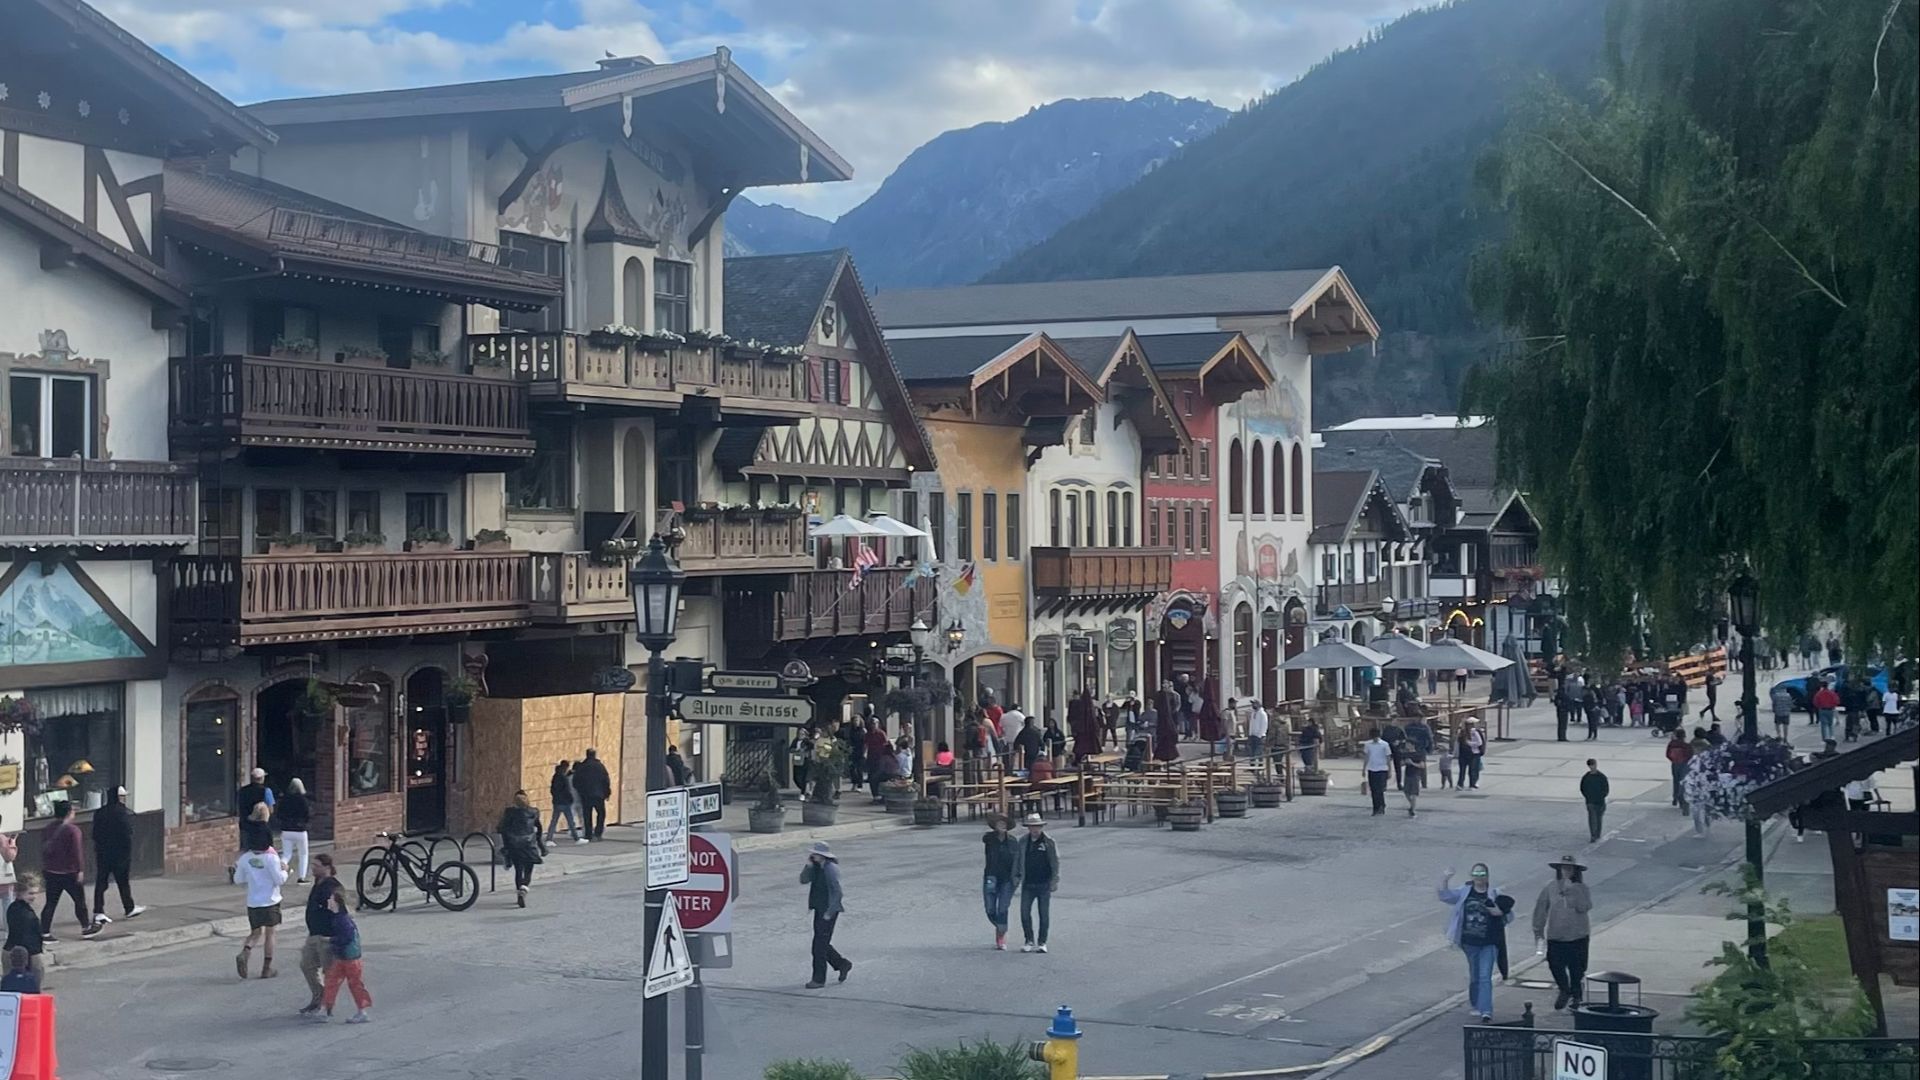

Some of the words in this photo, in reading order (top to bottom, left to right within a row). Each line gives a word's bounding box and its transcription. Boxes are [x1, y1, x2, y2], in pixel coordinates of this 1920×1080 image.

[736, 678, 771, 686] Street
[693, 699, 733, 717] Alpen
[739, 701, 799, 718] Strasse
[689, 798, 701, 812] NE
[703, 796, 718, 810] WAY
[656, 808, 679, 818] PARKING
[690, 852, 717, 866] NOT
[674, 896, 711, 911] NTER
[1564, 1051, 1596, 1077] NO
